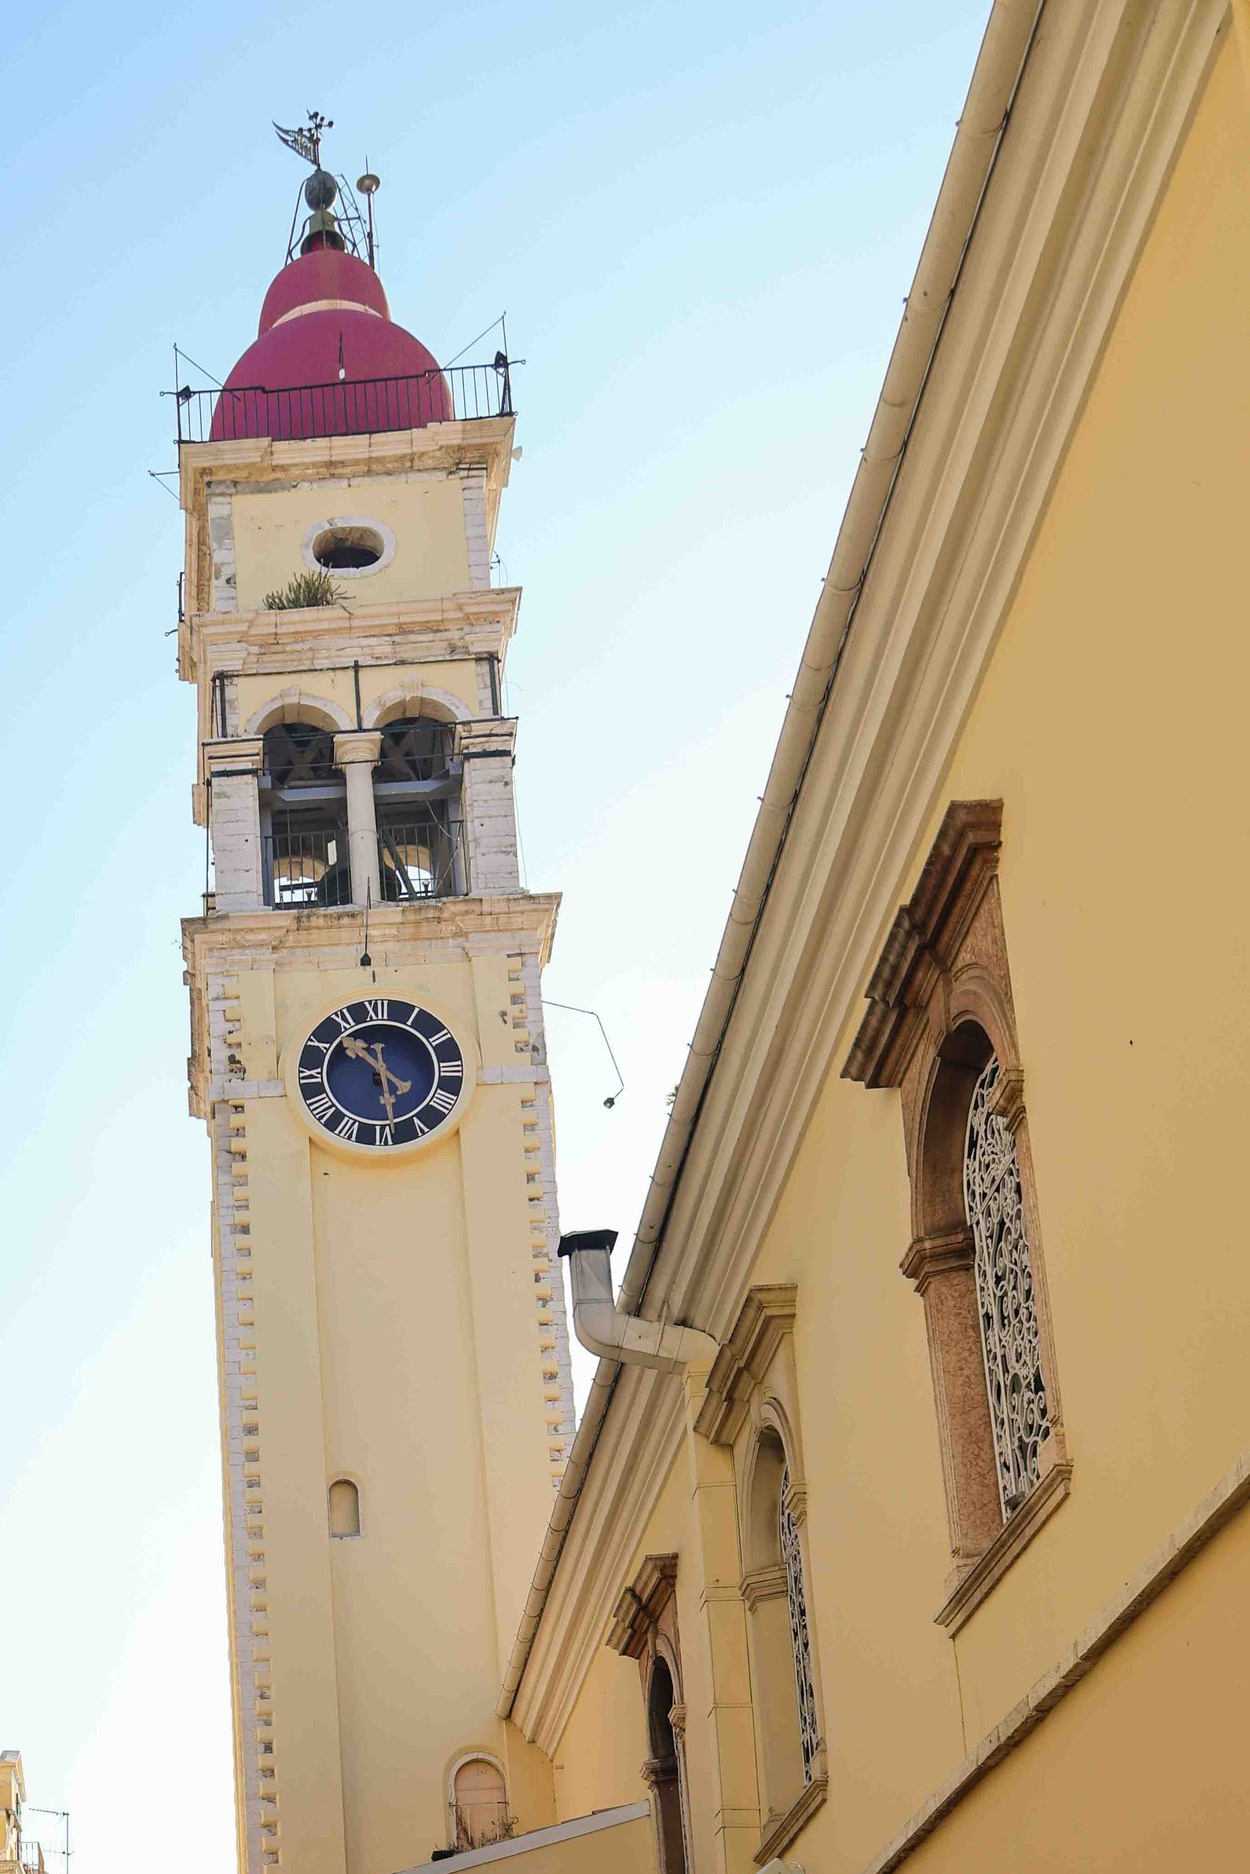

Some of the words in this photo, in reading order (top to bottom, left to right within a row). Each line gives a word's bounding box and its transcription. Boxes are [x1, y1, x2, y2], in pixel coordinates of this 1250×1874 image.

[330, 1008, 356, 1032] XI
[364, 1000, 388, 1021] XII
[406, 1008, 420, 1025] I
[307, 1035, 330, 1053] X
[428, 1030, 452, 1046] II
[440, 1060, 462, 1077] III
[306, 1094, 335, 1124] VIII
[430, 1088, 458, 1114] IIII
[334, 1117, 359, 1142] VII
[375, 1126, 394, 1145] VI
[413, 1116, 430, 1136] V
